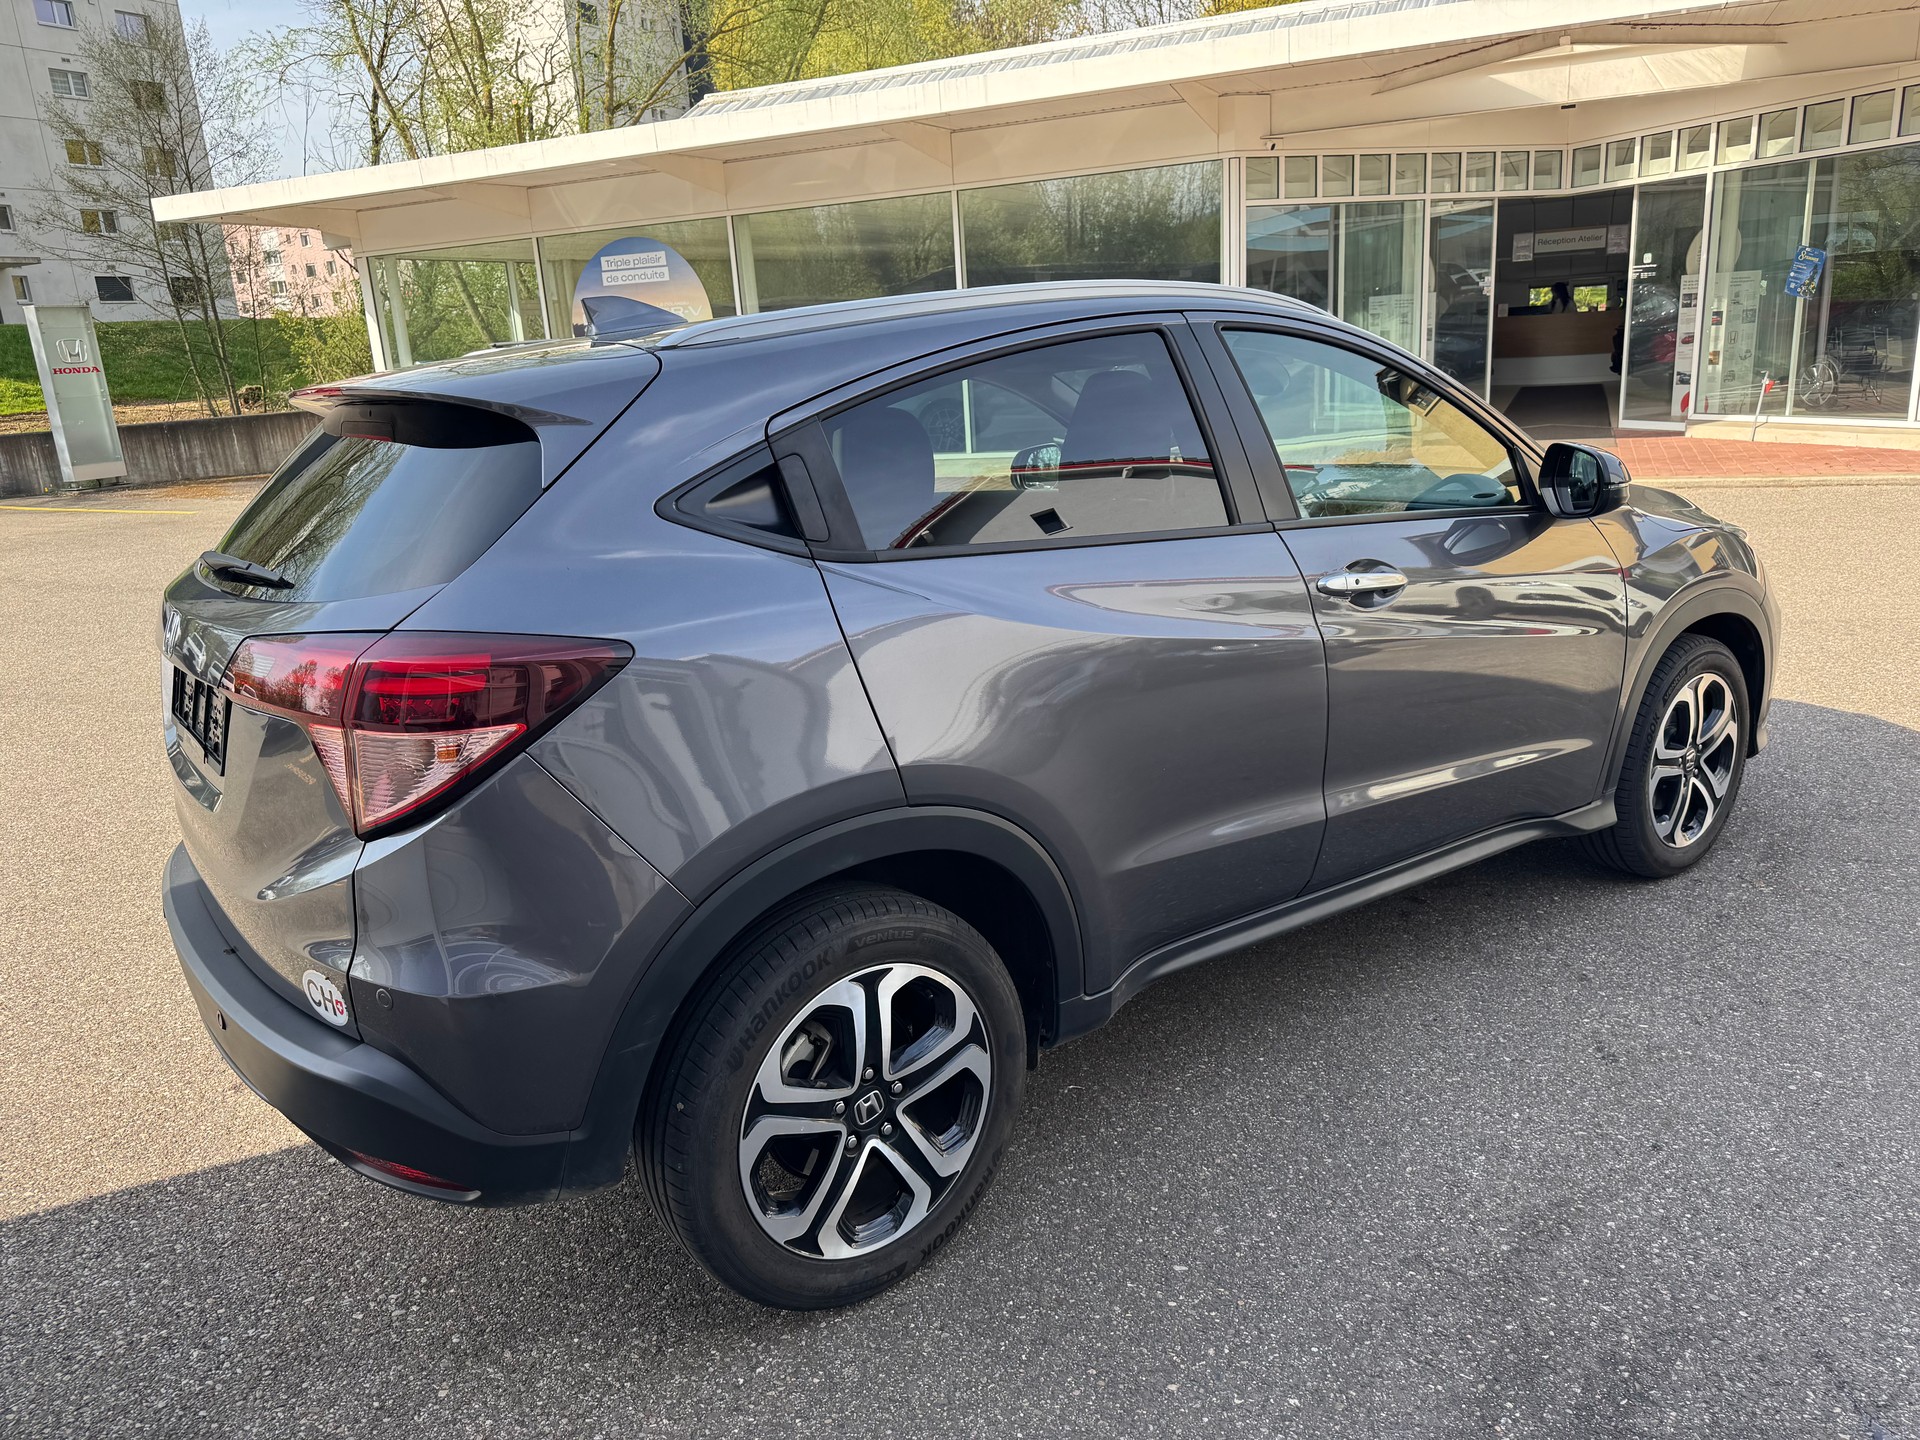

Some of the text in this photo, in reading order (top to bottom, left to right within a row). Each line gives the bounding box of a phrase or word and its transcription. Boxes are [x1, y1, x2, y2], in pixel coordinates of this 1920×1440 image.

[1578, 234, 1603, 243] Atelier
[605, 254, 661, 268] Triple plaisir
[606, 270, 665, 283] de conduite
[52, 366, 101, 375] HONDA
[307, 979, 338, 1017] CH
